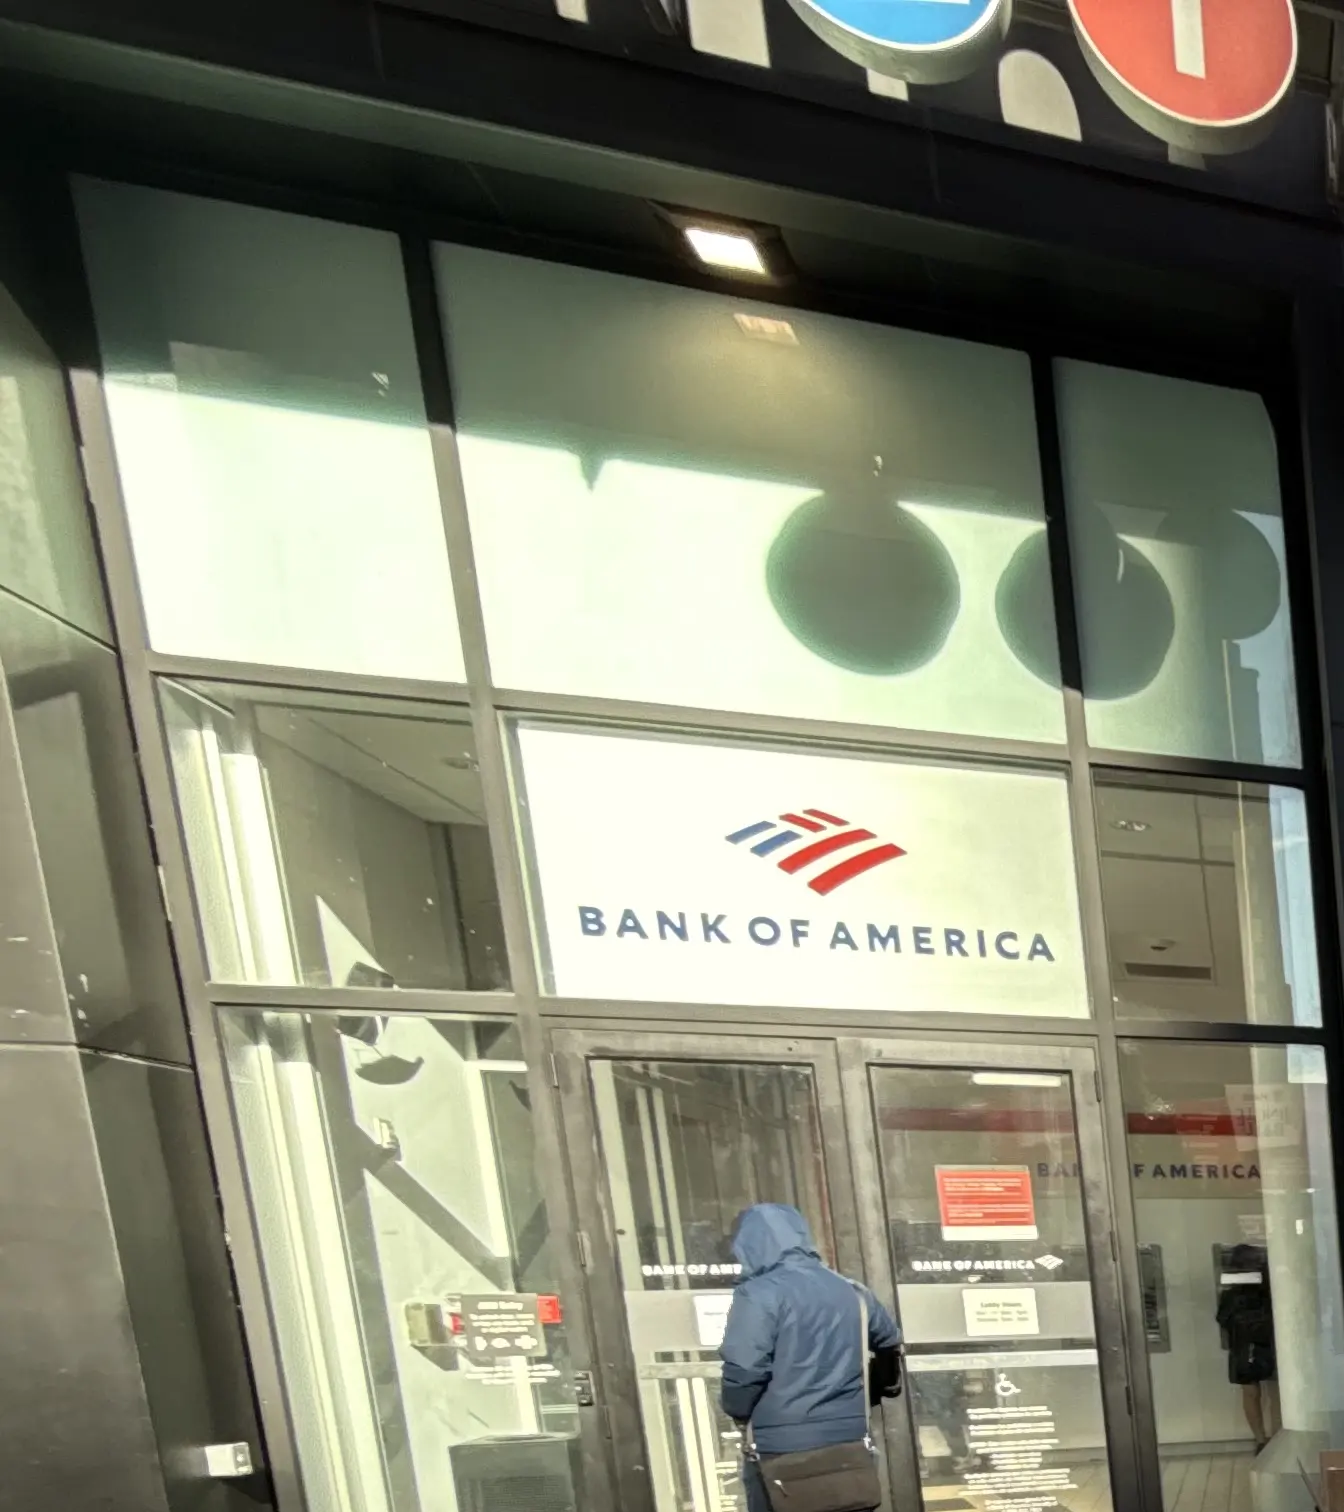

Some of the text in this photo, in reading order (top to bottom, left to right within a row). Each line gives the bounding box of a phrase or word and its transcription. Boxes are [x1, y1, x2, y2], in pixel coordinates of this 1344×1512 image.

[578, 905, 1055, 962] BANK OF AMERICA
[1038, 1162, 1082, 1178] BA
[1152, 1164, 1261, 1179] AMERICA
[642, 1264, 686, 1276] BANK
[912, 1259, 1035, 1271] BANK OF AMERICA
